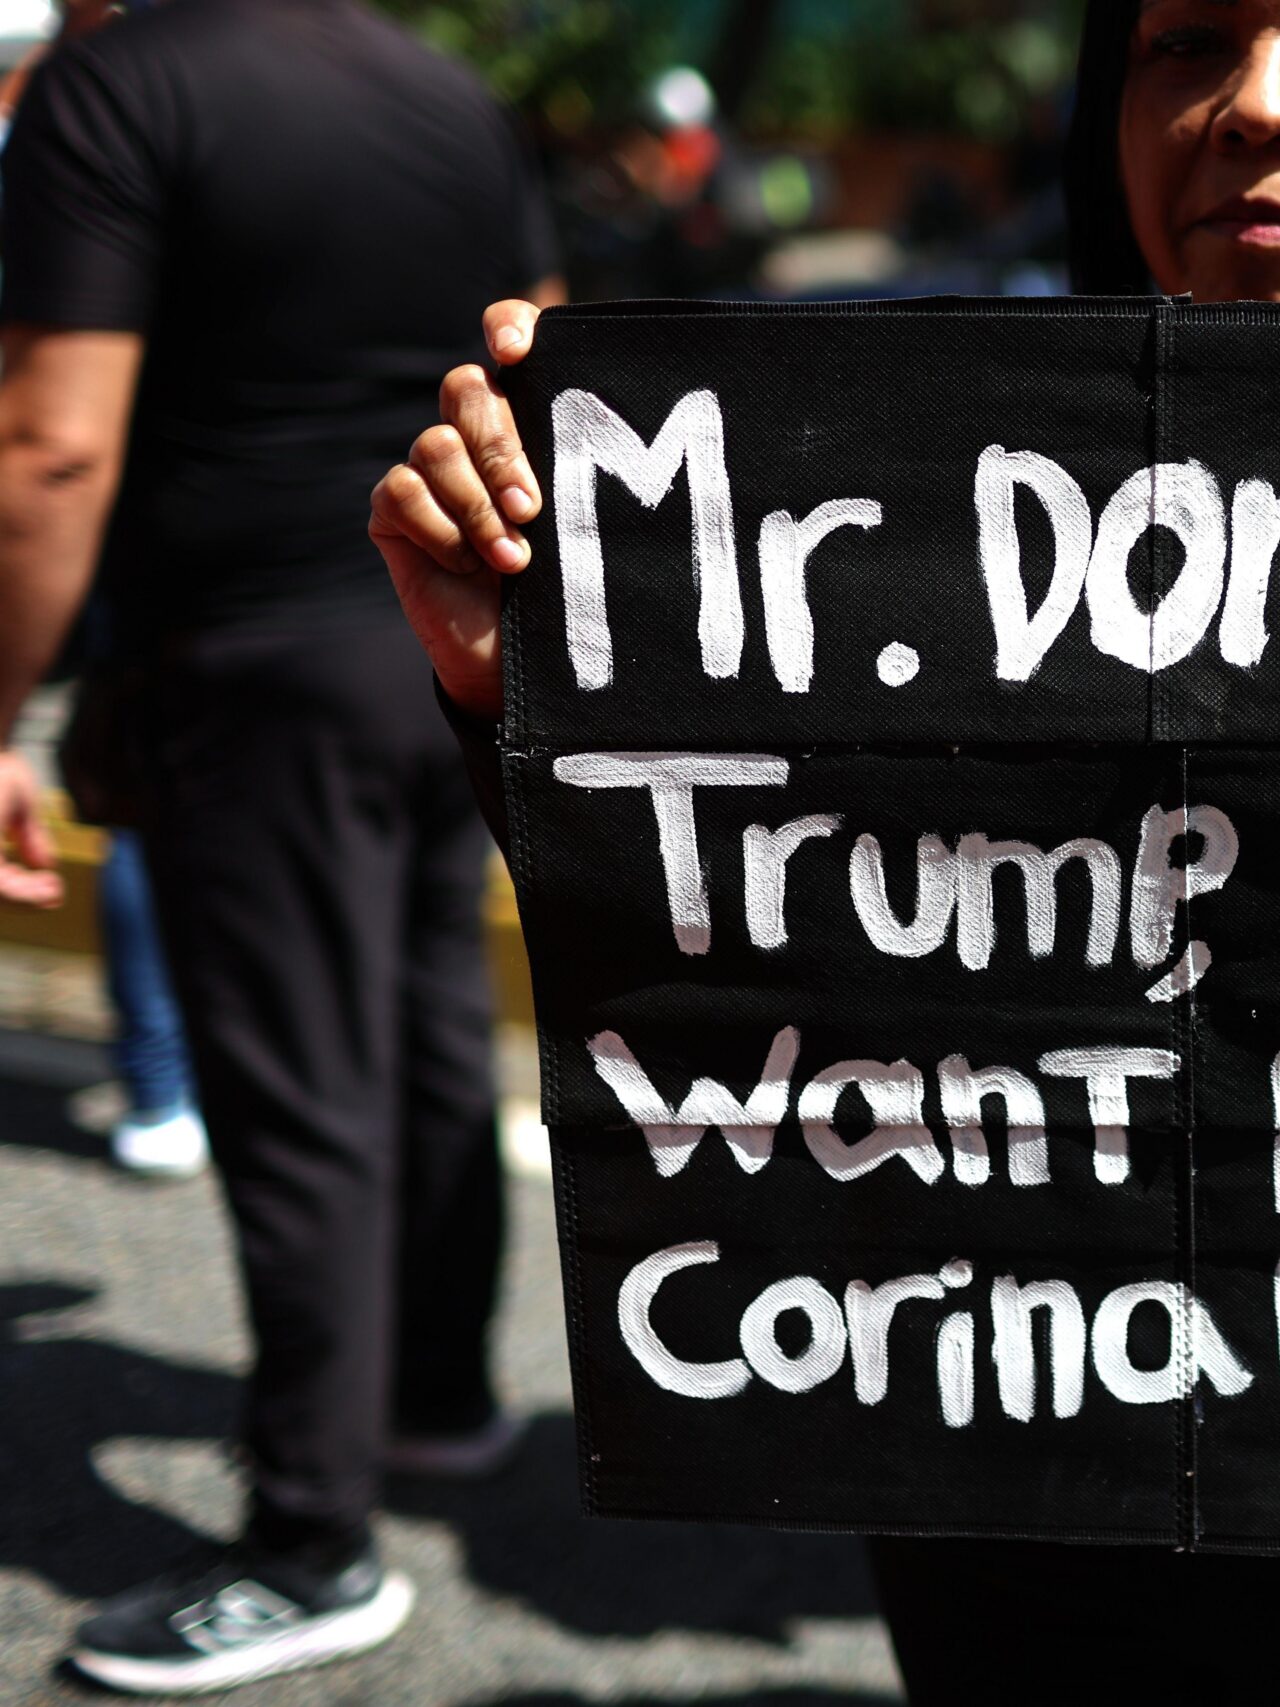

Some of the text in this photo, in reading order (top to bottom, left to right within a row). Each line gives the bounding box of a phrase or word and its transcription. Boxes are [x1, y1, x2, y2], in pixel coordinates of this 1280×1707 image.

[551, 388, 920, 694] Mr.
[553, 752, 1240, 1003] Trump,
[617, 1241, 1254, 1428] Corina
